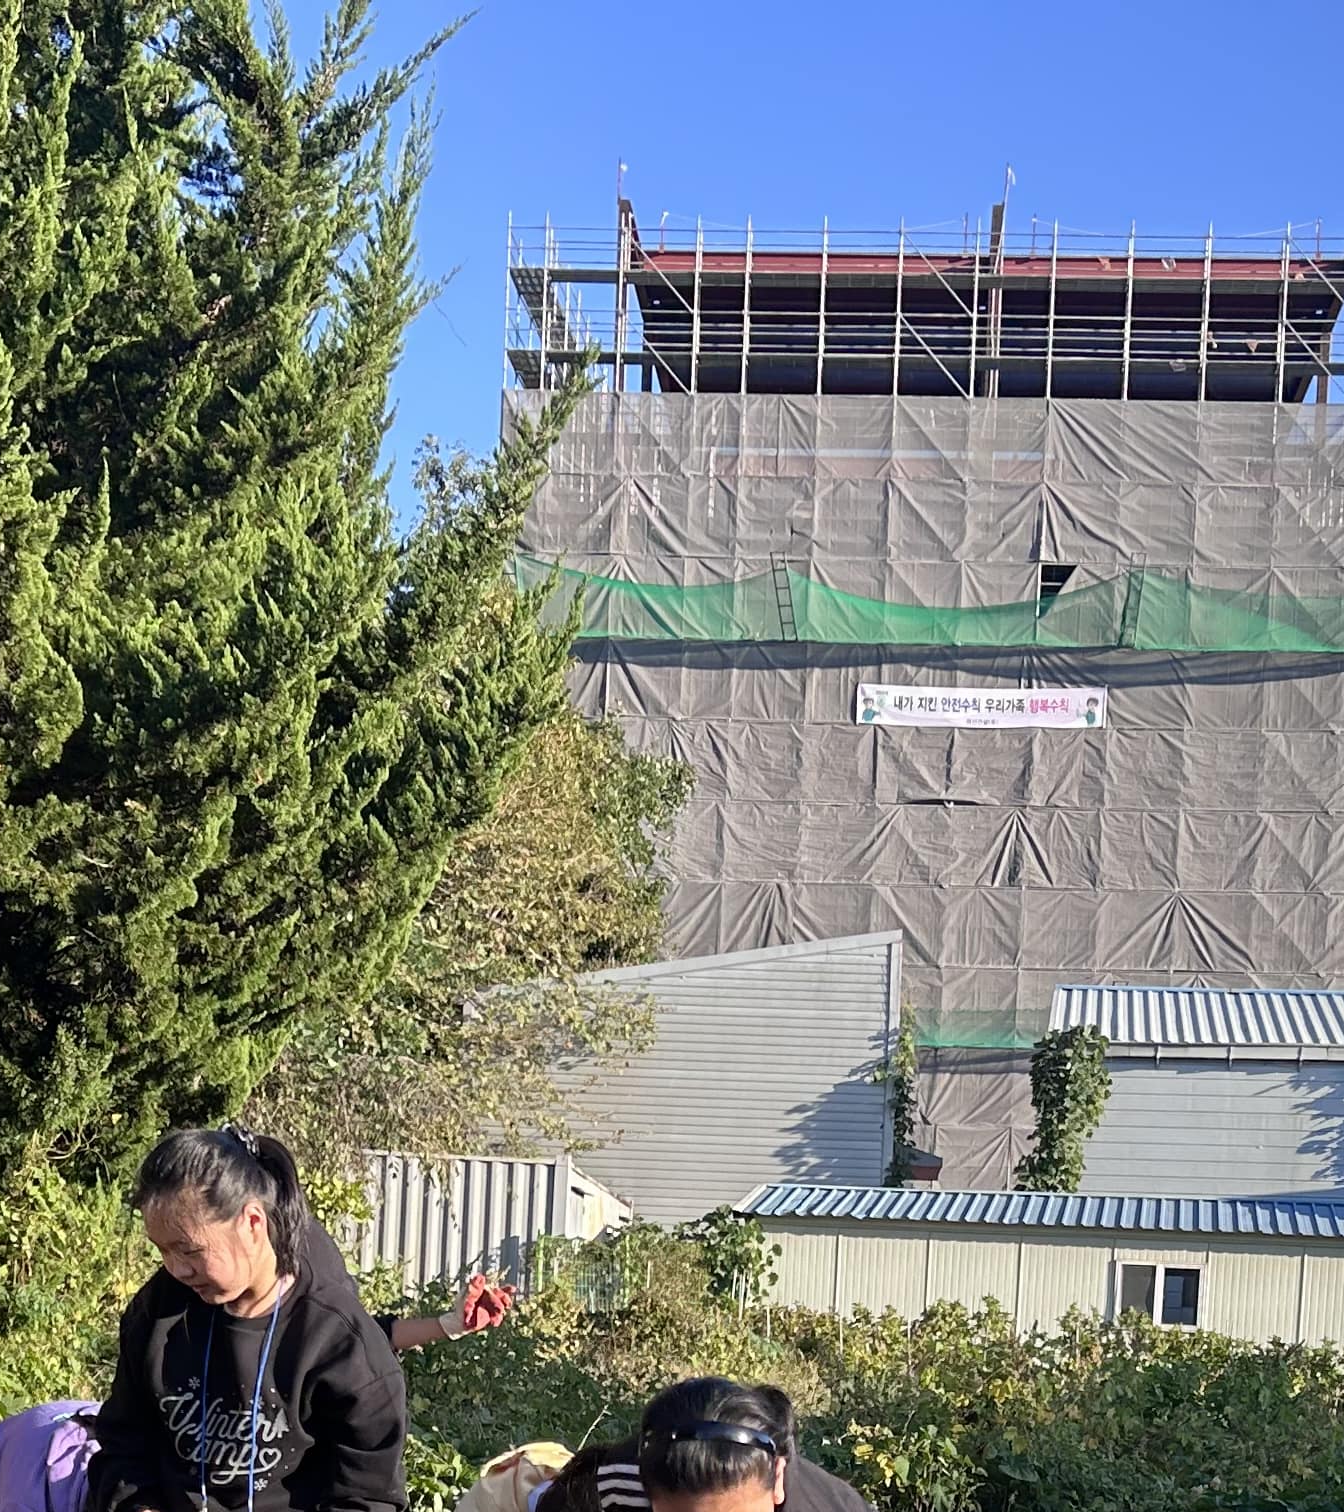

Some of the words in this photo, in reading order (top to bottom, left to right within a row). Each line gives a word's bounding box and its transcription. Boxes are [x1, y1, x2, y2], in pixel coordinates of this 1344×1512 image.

[893, 696, 913, 710] 내가
[917, 696, 938, 711] 지킨
[941, 697, 981, 713] 안전수칙
[984, 698, 1026, 714] 우리가족
[1029, 698, 1070, 714] 행복수칙
[159, 1392, 278, 1442] Winter
[175, 1423, 281, 1485] Camp
